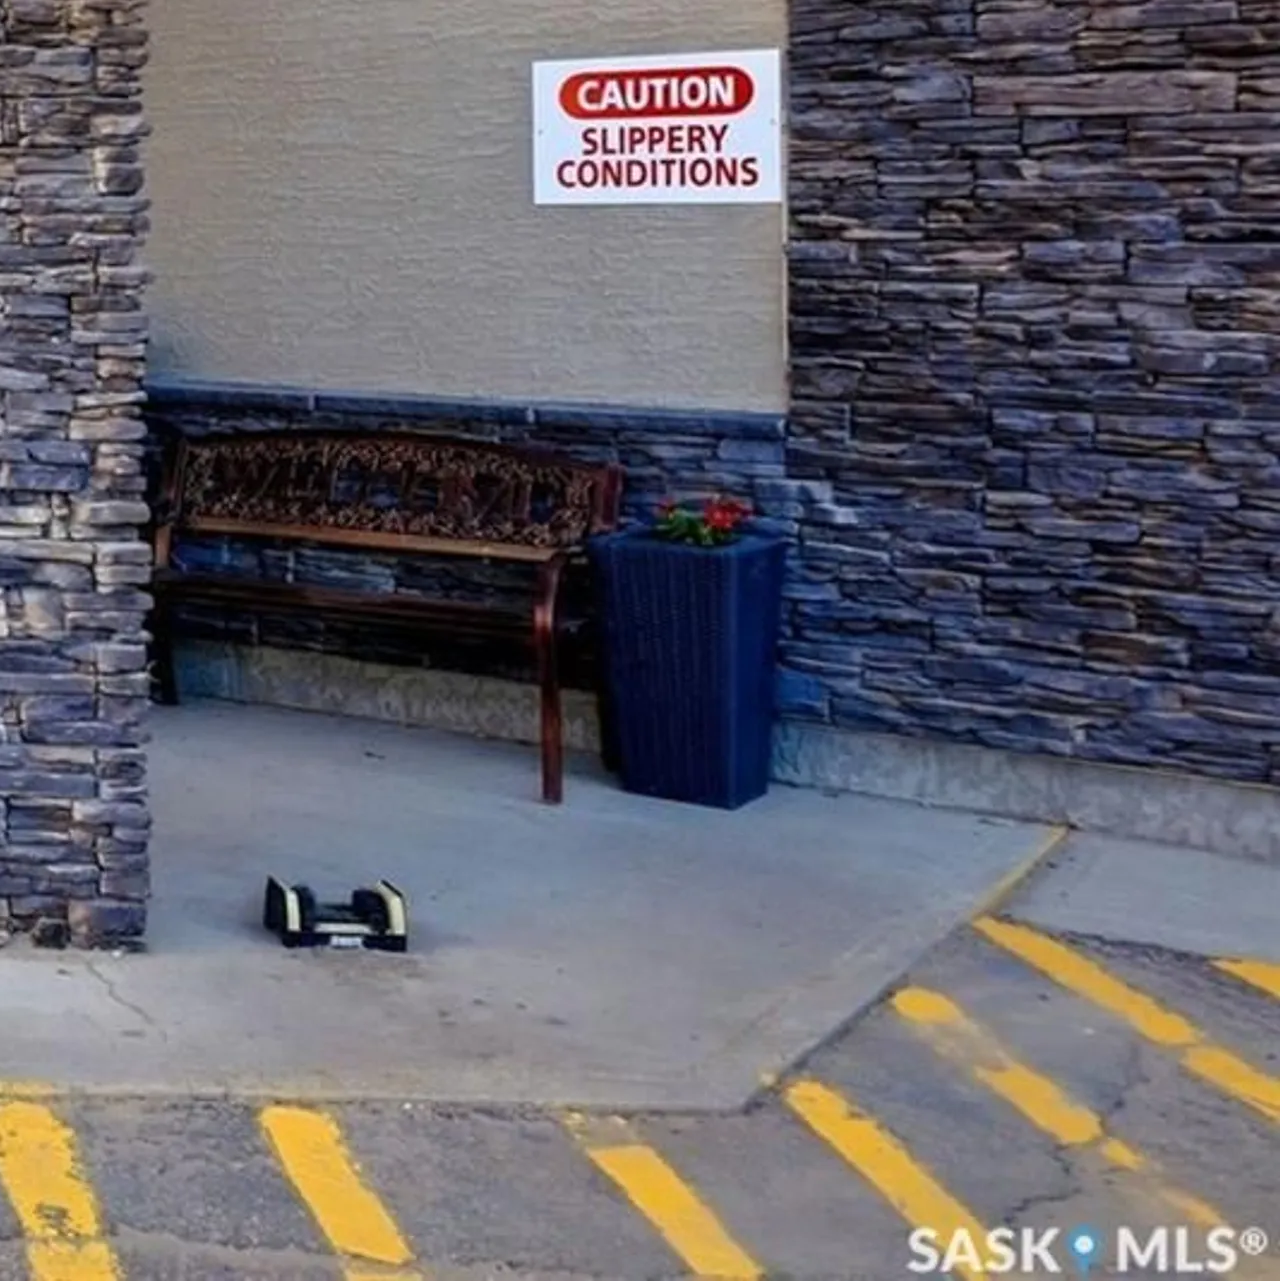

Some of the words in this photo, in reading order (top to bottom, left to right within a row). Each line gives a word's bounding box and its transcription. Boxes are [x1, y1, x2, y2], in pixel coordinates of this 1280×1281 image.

[576, 74, 736, 111] CAUTION
[581, 123, 729, 156] SLIPPERY
[556, 157, 759, 189] CONDITIONS
